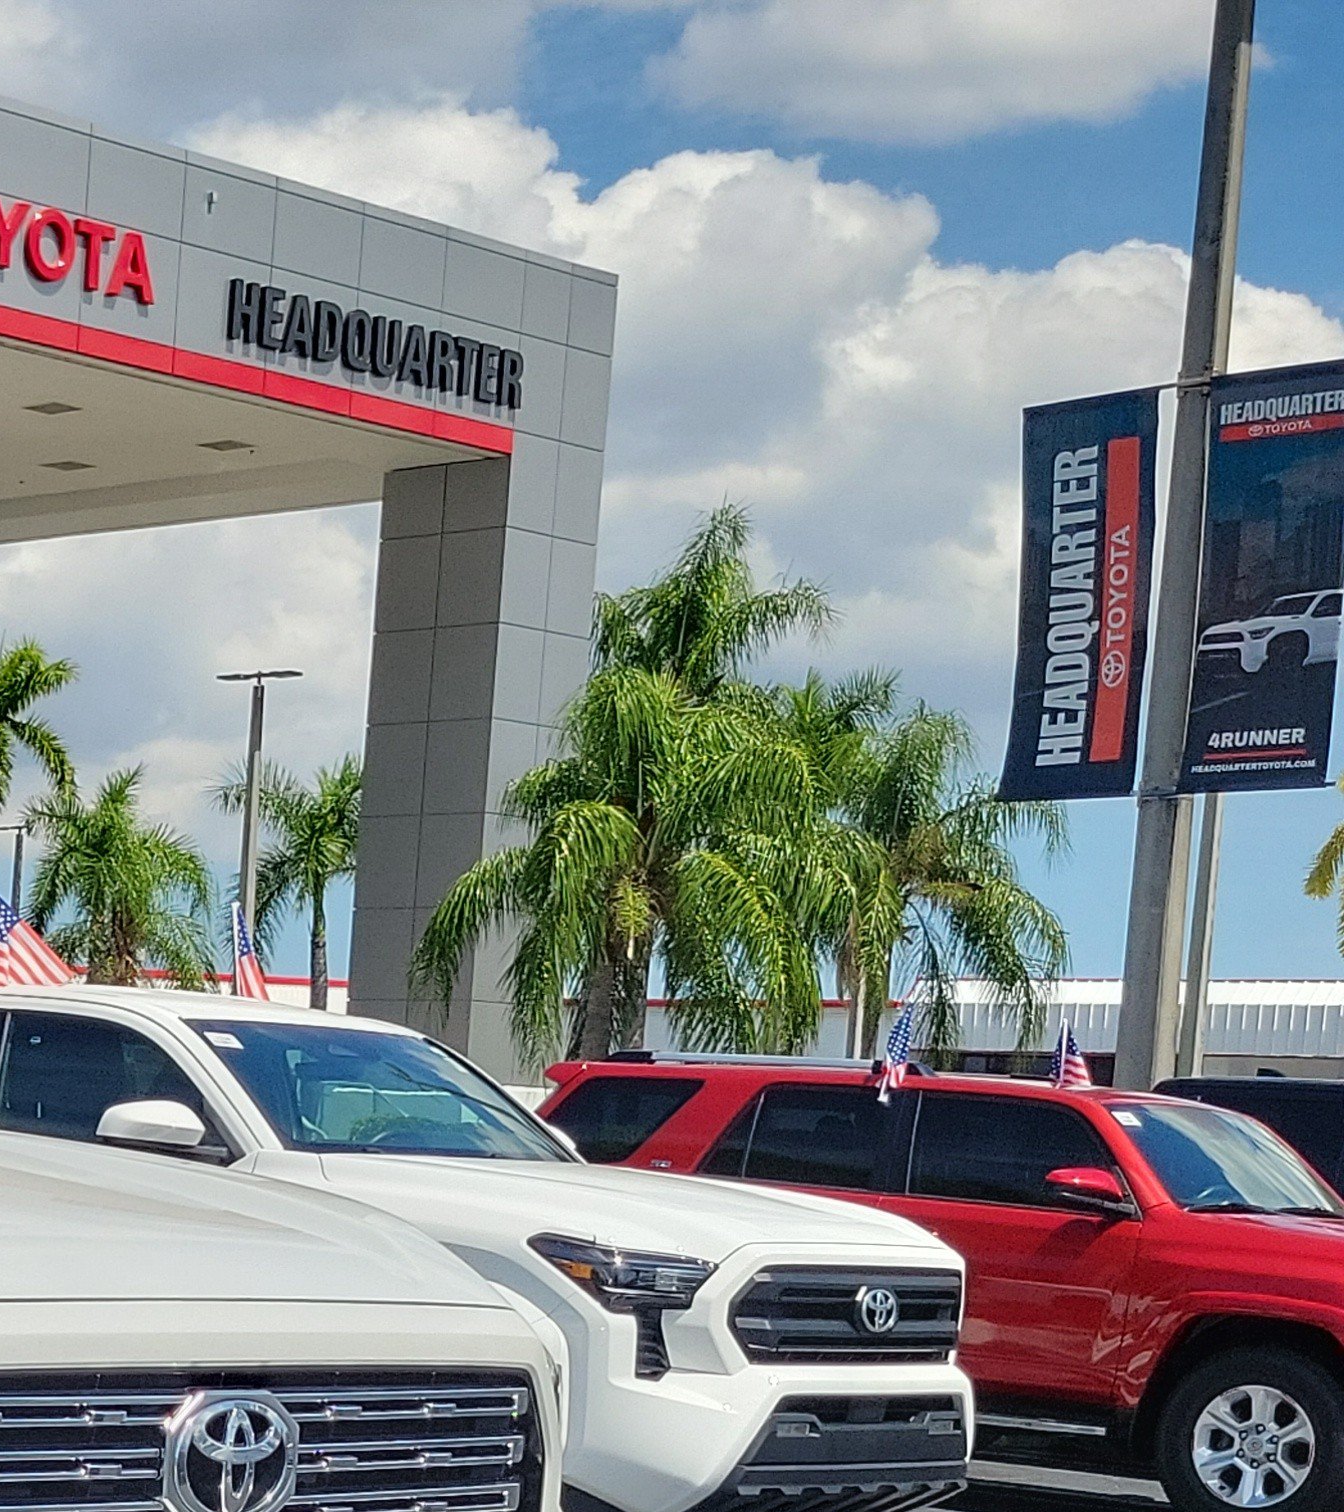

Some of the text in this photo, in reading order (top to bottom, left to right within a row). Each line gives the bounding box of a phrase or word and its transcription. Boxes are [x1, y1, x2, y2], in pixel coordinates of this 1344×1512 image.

[226, 278, 525, 409] HEADQUARTER
[1220, 389, 1344, 425] HEADQUARTER
[1265, 419, 1312, 434] TOYOTA
[1035, 444, 1099, 767] HEADQUARTER
[1106, 524, 1130, 646] TOYOTA
[1207, 728, 1306, 749] 4RUNNER
